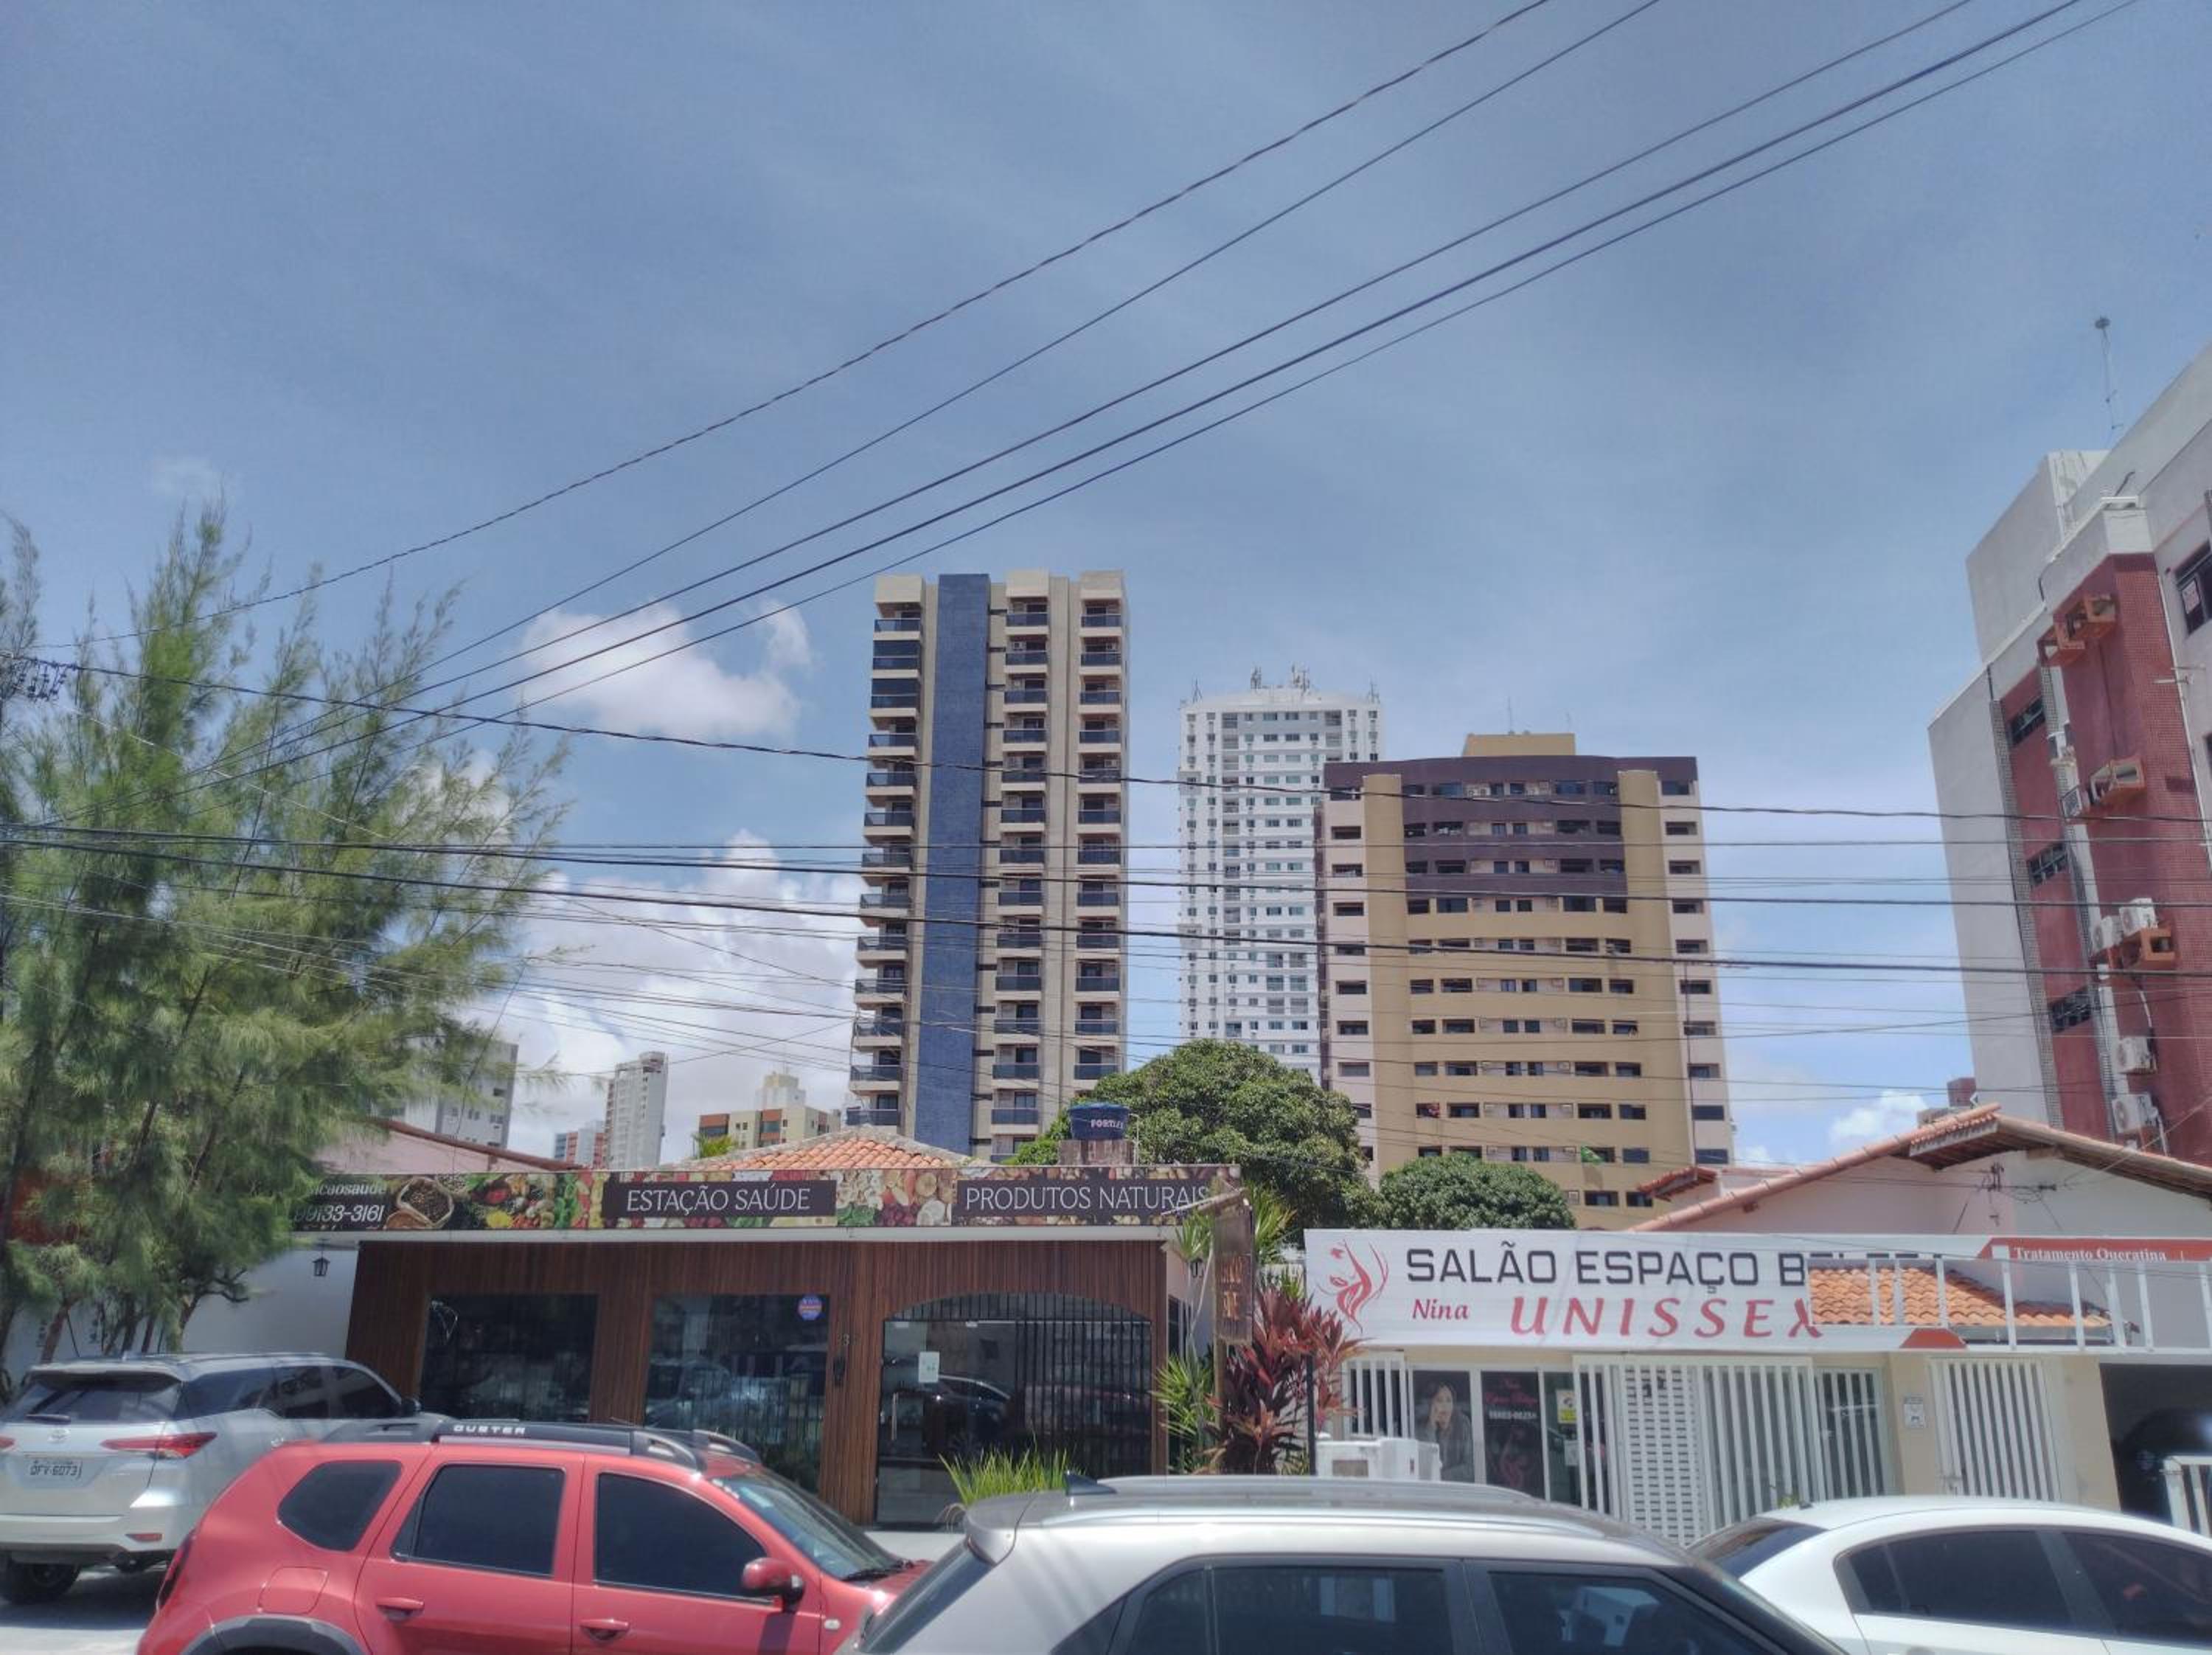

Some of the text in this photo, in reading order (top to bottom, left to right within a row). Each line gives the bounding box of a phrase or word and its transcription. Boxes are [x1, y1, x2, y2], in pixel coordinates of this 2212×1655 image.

[627, 1182, 810, 1216] ESTAÇÃO SAÚDE
[966, 1186, 1210, 1210] PRODUTOS NATURAIS
[1406, 1241, 1557, 1283] SALÃO
[1576, 1251, 1759, 1294] ESPAÇO
[2014, 1247, 2093, 1262] Tratamento
[1412, 1298, 1469, 1320] Nina
[1511, 1295, 1823, 1338] UNISSEX
